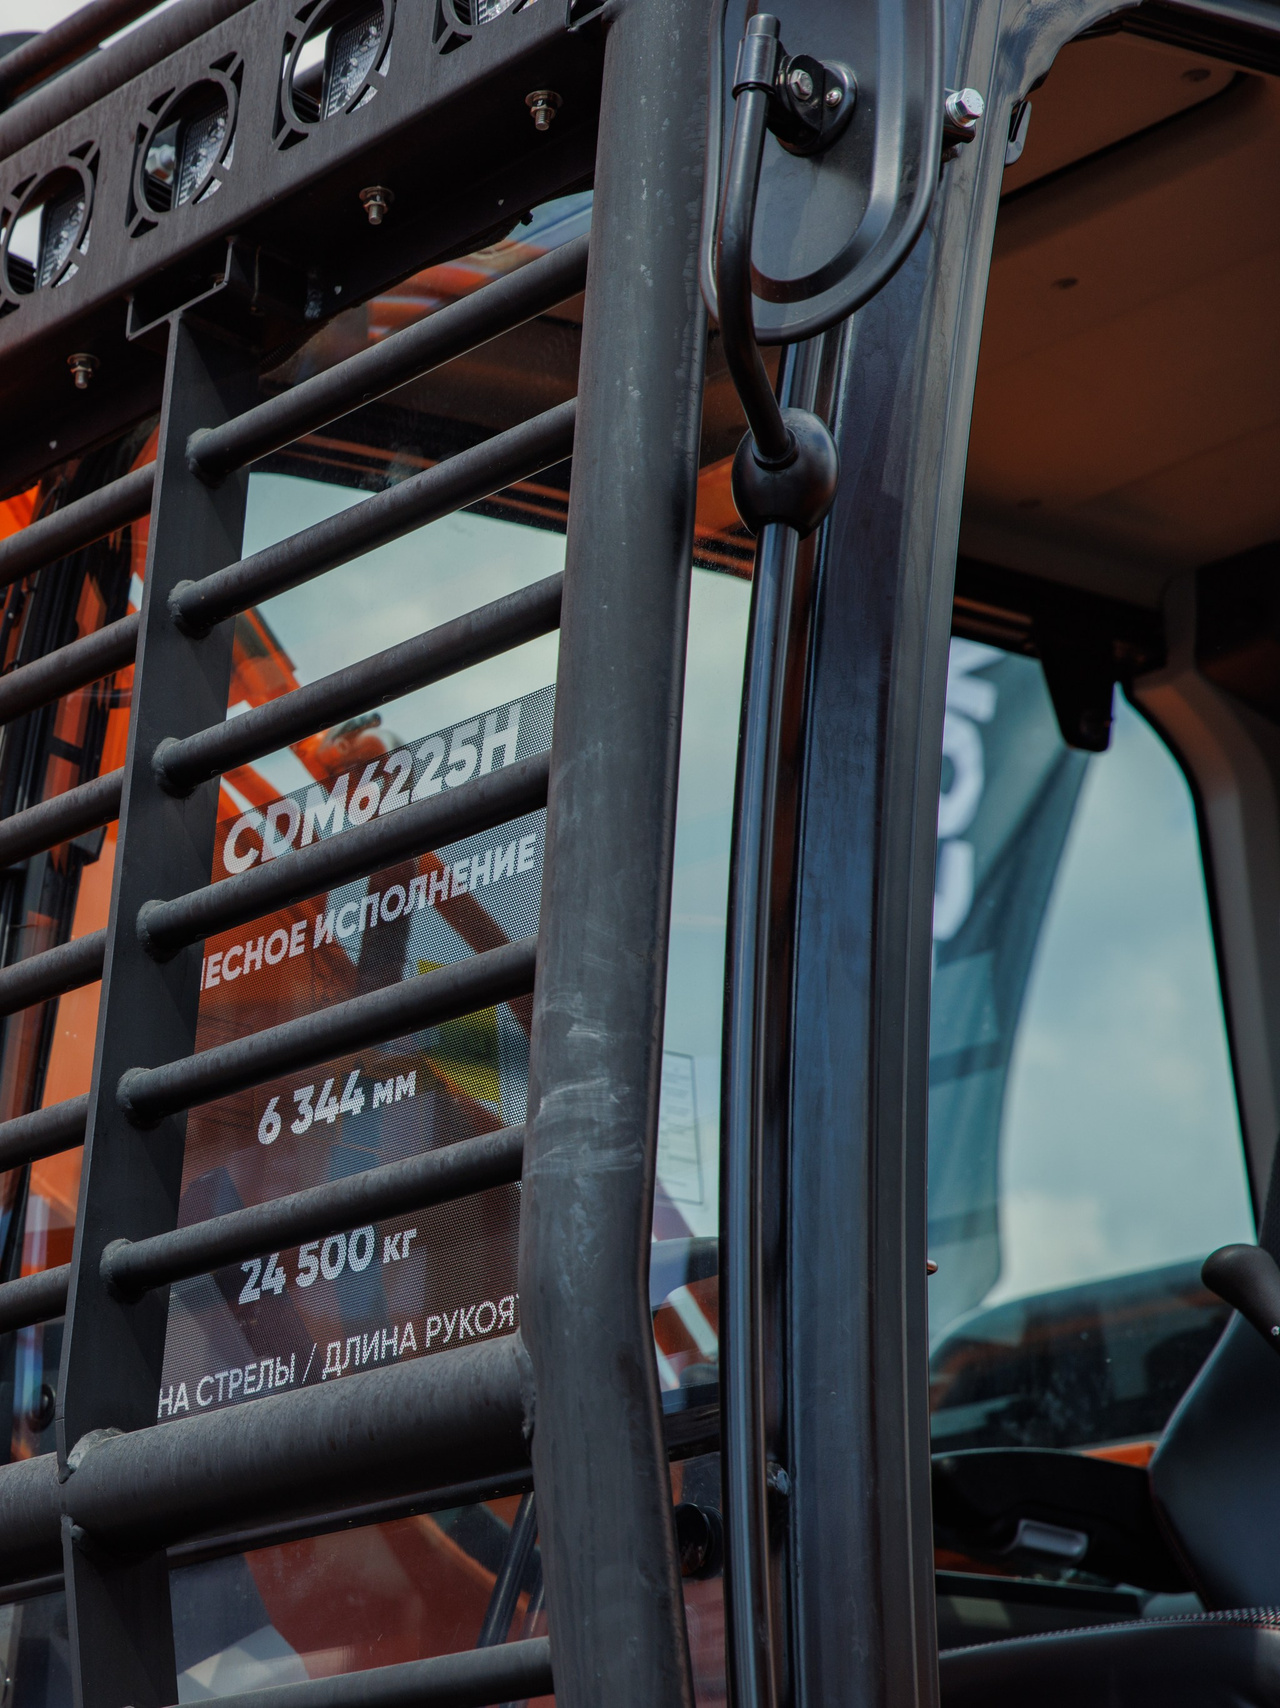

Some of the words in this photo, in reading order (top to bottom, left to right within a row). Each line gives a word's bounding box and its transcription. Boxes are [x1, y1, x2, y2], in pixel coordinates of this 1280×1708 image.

[223, 702, 520, 874] CDM6225H
[200, 919, 308, 991] ЕСНОЕ
[313, 833, 537, 949] ИСПОЛНЕНИЕ
[258, 1095, 282, 1145] 6
[290, 1069, 365, 1135] 344
[238, 1252, 287, 1305] 24
[295, 1225, 375, 1287] 500
[196, 1352, 296, 1407] СТРЕЛЫ
[322, 1321, 418, 1380] ДЛИНА
[425, 1293, 520, 1348] РУКОЯ
